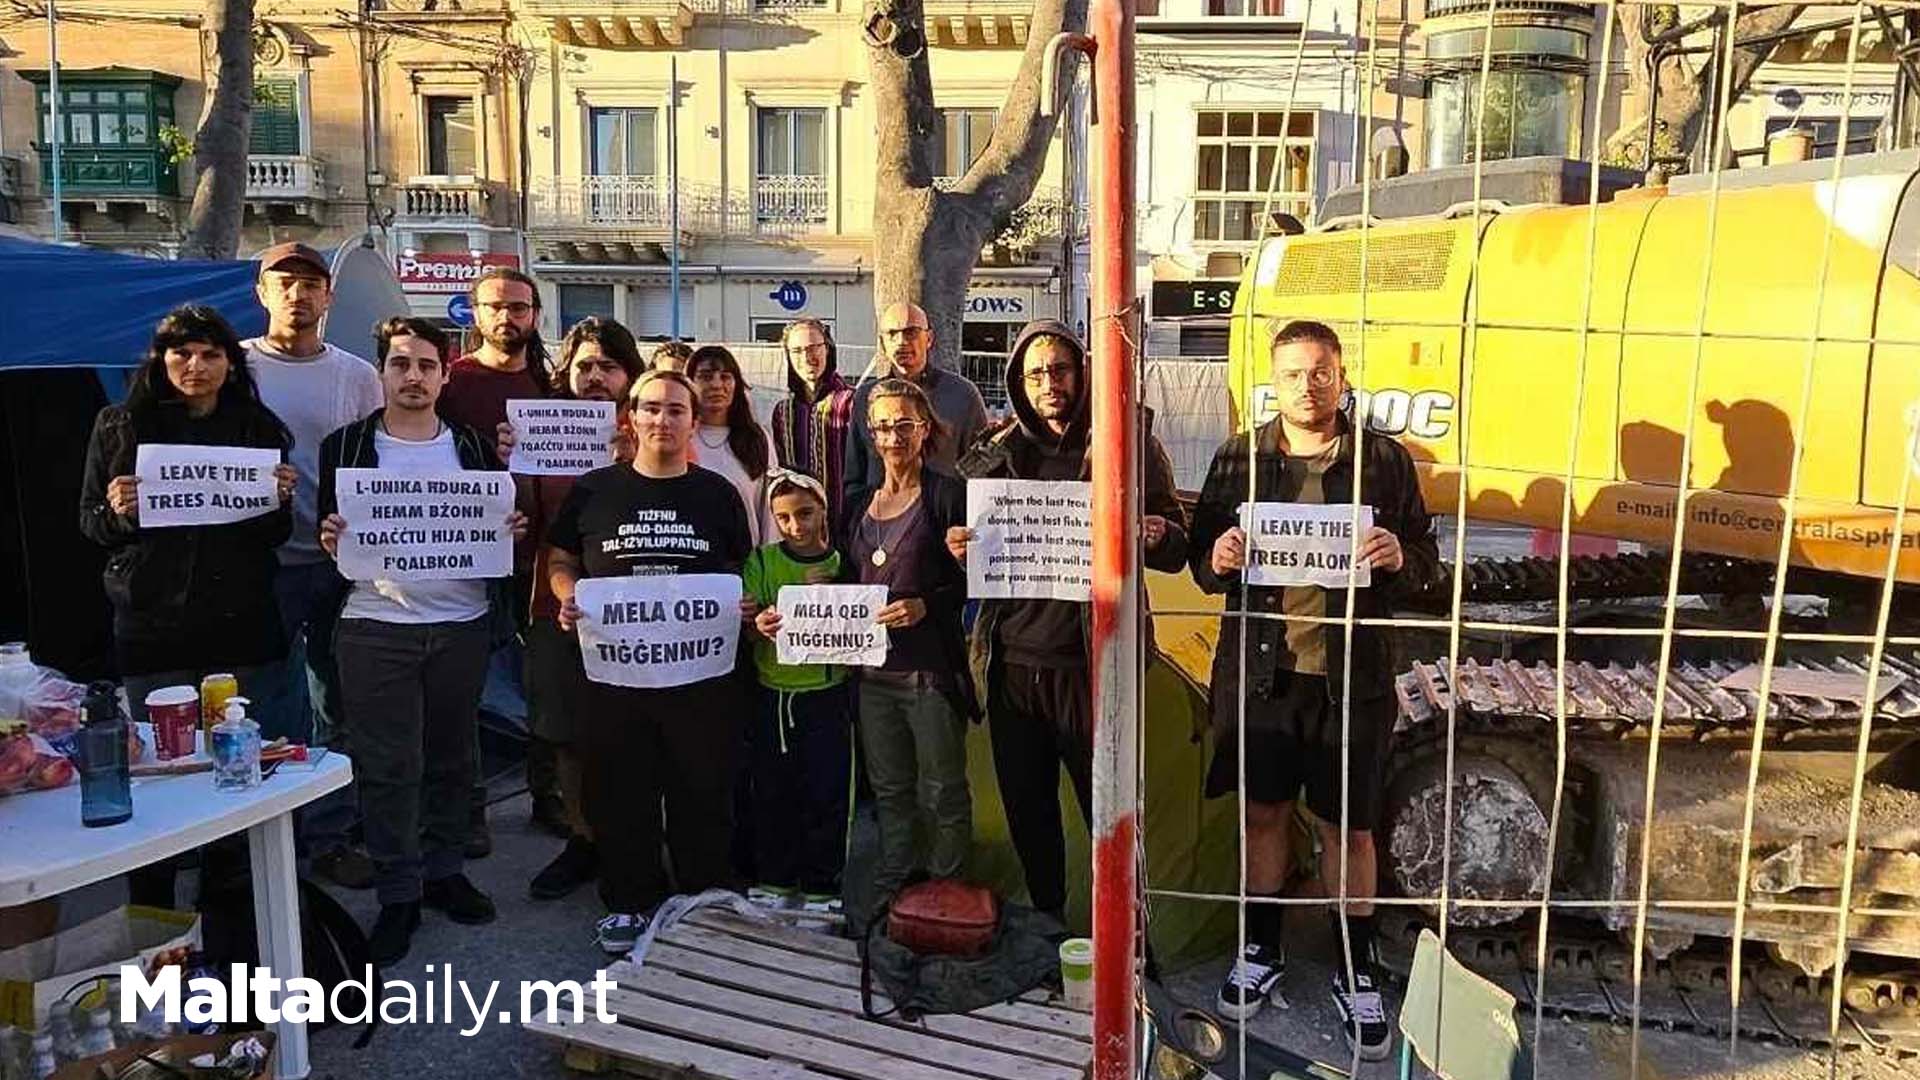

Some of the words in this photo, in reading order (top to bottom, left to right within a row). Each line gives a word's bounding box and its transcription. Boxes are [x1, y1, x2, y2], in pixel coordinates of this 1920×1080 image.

[400, 257, 497, 280] Premie
[1193, 290, 1232, 309] E-S
[518, 408, 559, 418] L-UNIKA
[597, 410, 605, 419] LI
[528, 425, 561, 436] HEMM
[563, 423, 597, 436] BŻONN
[566, 442, 588, 452] HIJA
[590, 443, 607, 452] DIK
[160, 465, 218, 481] LEAVE
[223, 466, 259, 482] THE
[356, 481, 422, 495] L-UNIKA
[428, 481, 481, 496] ĦDURA
[487, 482, 499, 496] LI
[147, 493, 205, 510] TREES
[210, 494, 270, 510] ALONE
[1026, 495, 1043, 506] the
[1046, 496, 1064, 506] last
[372, 505, 423, 519] HEMM
[429, 502, 484, 519] BŻONN
[987, 515, 1020, 527] down,
[1023, 515, 1039, 526] the
[1043, 515, 1061, 526] last
[1063, 516, 1082, 527] fish
[1260, 519, 1314, 536] LEAVE
[1319, 521, 1352, 537] THE
[357, 527, 426, 546] TQAĊĊTU
[432, 530, 466, 543] HIJA
[470, 530, 497, 543] DIK
[1004, 534, 1023, 544] and
[1026, 534, 1043, 544] the
[1046, 534, 1064, 545] last
[1066, 538, 1092, 547] strea
[384, 555, 474, 571] F'QALBKOM
[989, 552, 1039, 567] poisoned,
[1041, 556, 1060, 566] you
[1062, 555, 1080, 566] will
[1082, 559, 1092, 567] re
[1251, 549, 1298, 567] TREES
[1304, 552, 1361, 570] ALON
[984, 572, 1005, 584] that
[1008, 575, 1026, 585] you
[1029, 574, 1061, 583] cannot
[1064, 575, 1080, 584] eat
[1082, 578, 1092, 586] m
[602, 600, 667, 625] MELA
[674, 599, 720, 623] QED
[793, 604, 833, 619] MELA
[839, 604, 869, 620] QED
[787, 628, 875, 648] TIĠĠENNU?
[596, 636, 725, 665] TIĠĠENNU?
